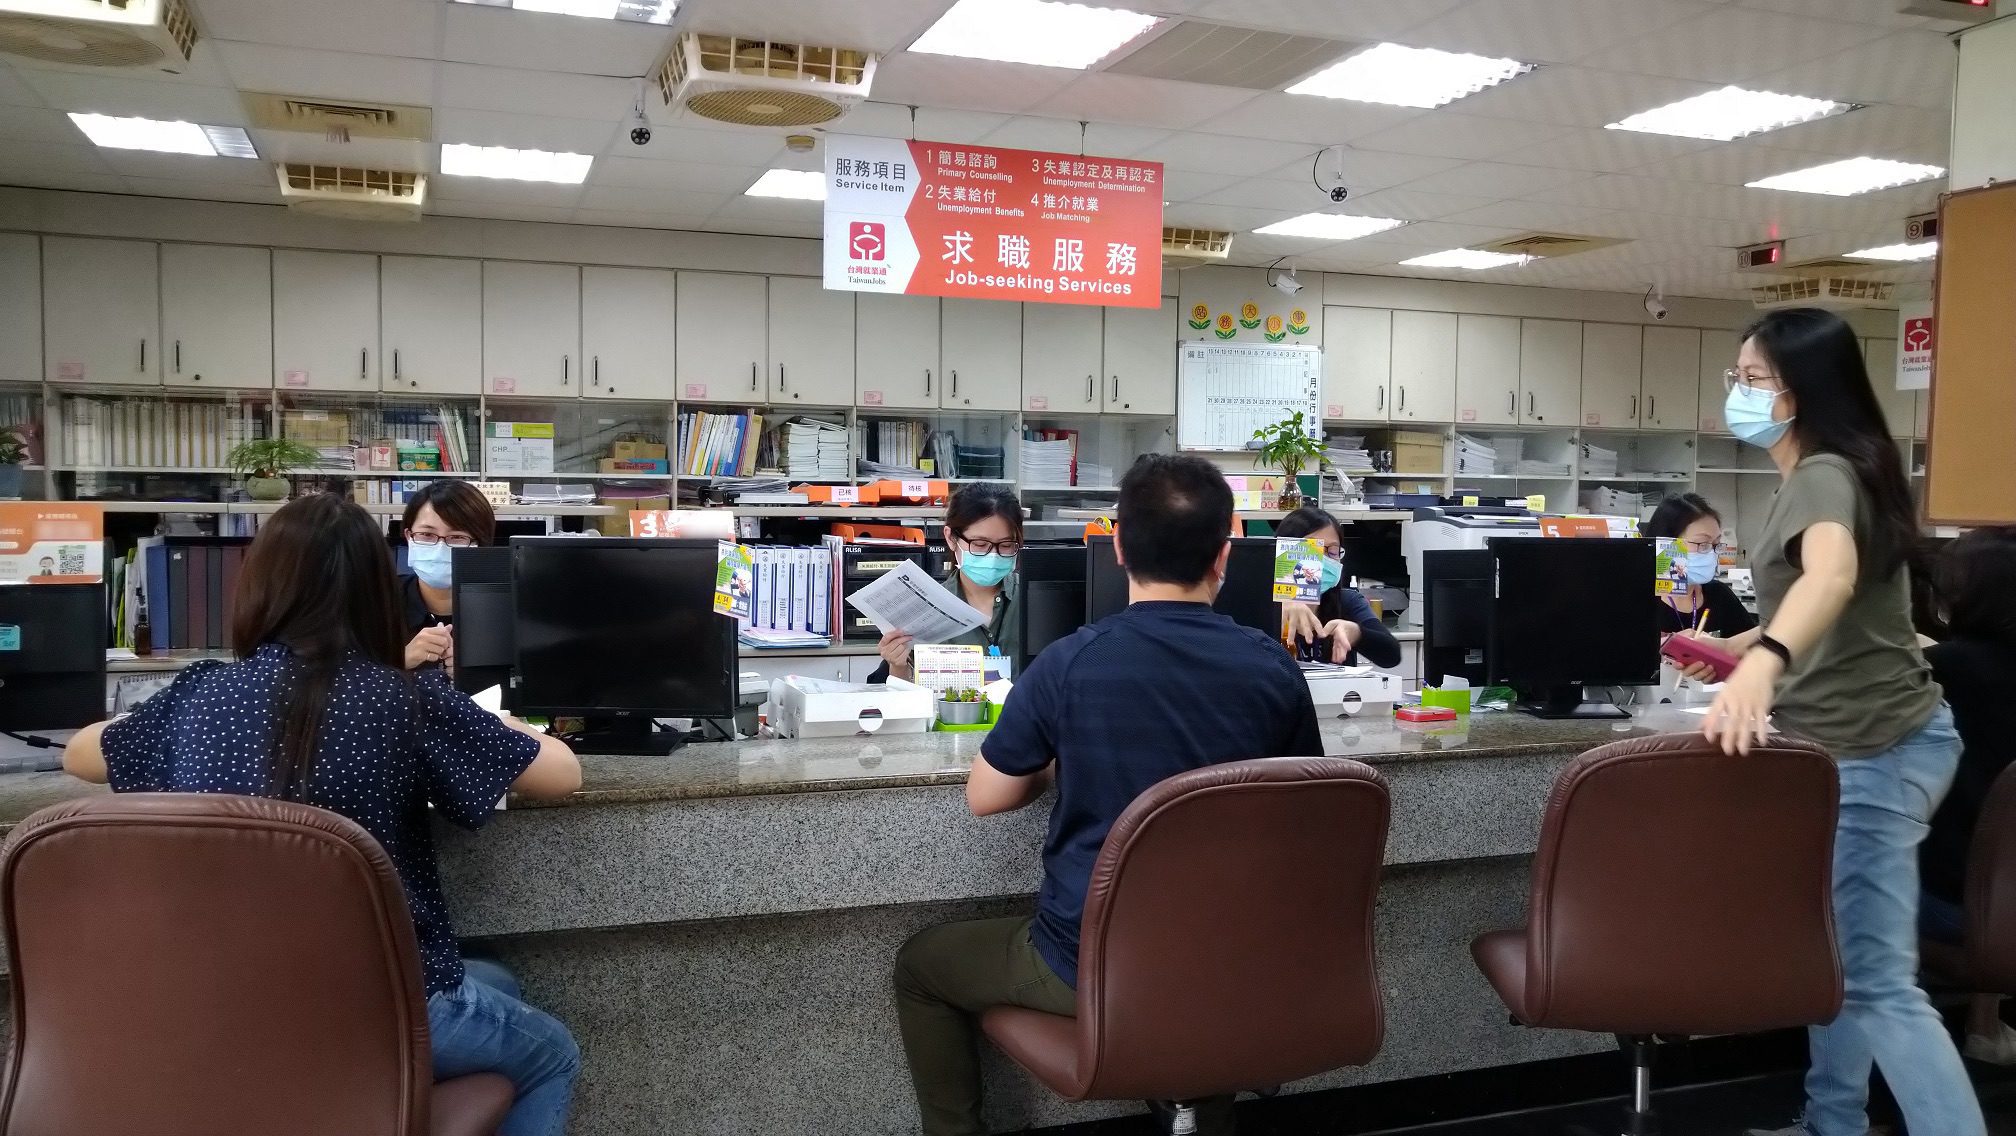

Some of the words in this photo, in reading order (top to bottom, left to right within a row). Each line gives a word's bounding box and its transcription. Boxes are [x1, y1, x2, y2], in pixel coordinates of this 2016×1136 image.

[926, 149, 932, 164] 1
[938, 150, 997, 169] 簡易諮詢
[835, 157, 906, 181] 服務項目
[937, 167, 966, 179] Primary
[969, 170, 1013, 183] Counselling
[1031, 158, 1040, 173] 3
[1043, 159, 1156, 183] 失業認定及再認定
[836, 178, 878, 191] Service
[881, 182, 905, 192] Item
[925, 184, 934, 199] 2
[938, 184, 997, 203] 失業給付
[1043, 176, 1095, 189] Unemployment
[1098, 181, 1146, 193] Determination
[937, 202, 992, 215] Unemployment
[995, 206, 1025, 217] Benefits
[1030, 193, 1039, 207] 4
[1043, 193, 1099, 212] 推介就業
[1041, 211, 1055, 219] Job
[1056, 213, 1090, 223] Matching
[941, 230, 1137, 276] 求職服務
[847, 265, 887, 276] 台灣就業通
[848, 275, 886, 285] TaiwanJobs
[945, 269, 1054, 294] Job-seeking
[1058, 276, 1132, 295] Services
